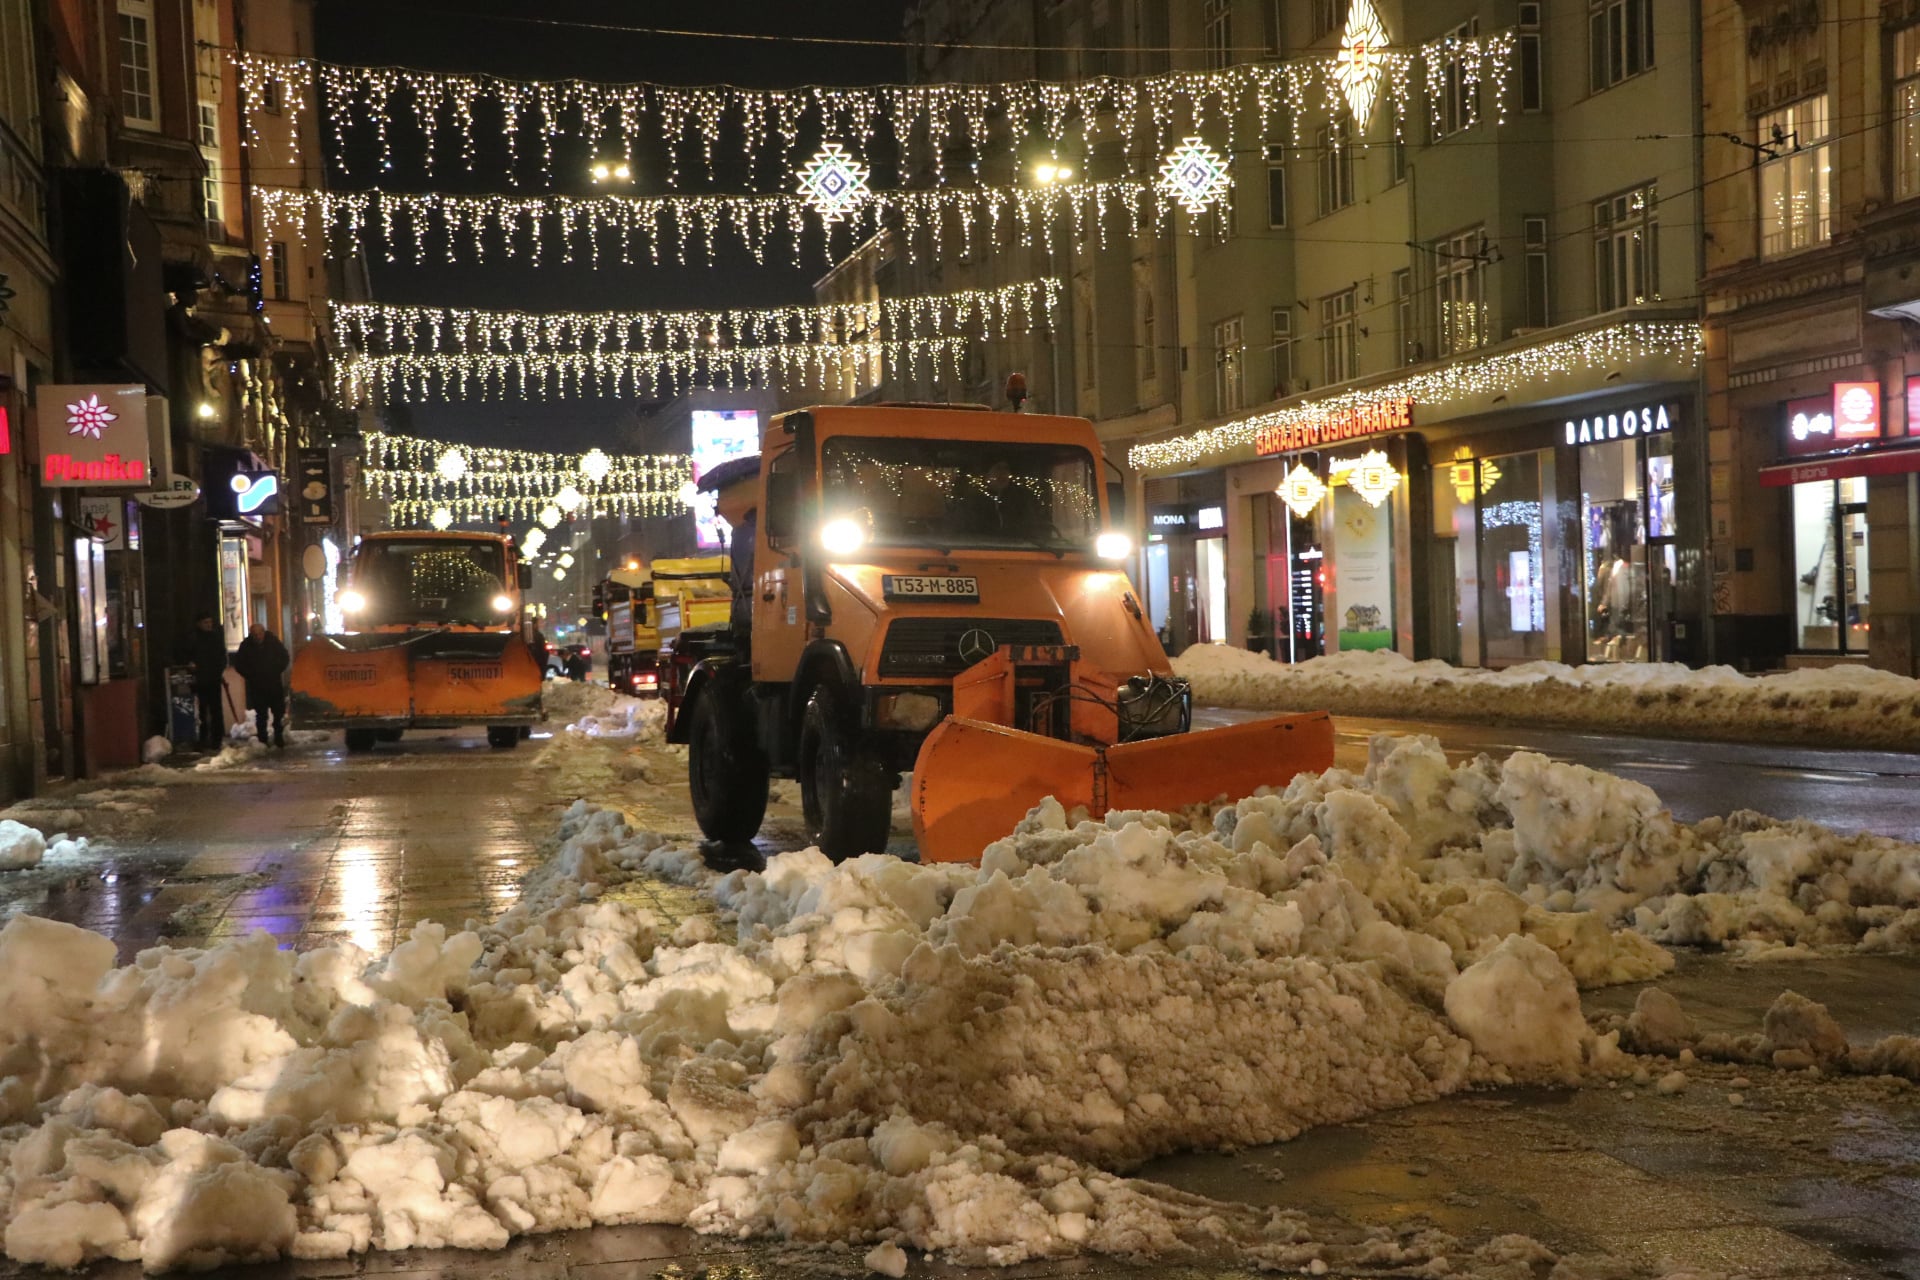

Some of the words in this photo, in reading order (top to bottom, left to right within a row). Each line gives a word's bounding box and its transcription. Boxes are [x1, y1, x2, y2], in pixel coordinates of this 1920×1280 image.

[1566, 404, 1669, 445] BARBOSA
[45, 454, 144, 481] Planika
[1153, 515, 1185, 525] MONA
[894, 578, 975, 594] T53-M-885
[327, 669, 373, 681] SCHMIDT
[450, 667, 499, 680] SCHMIDT
